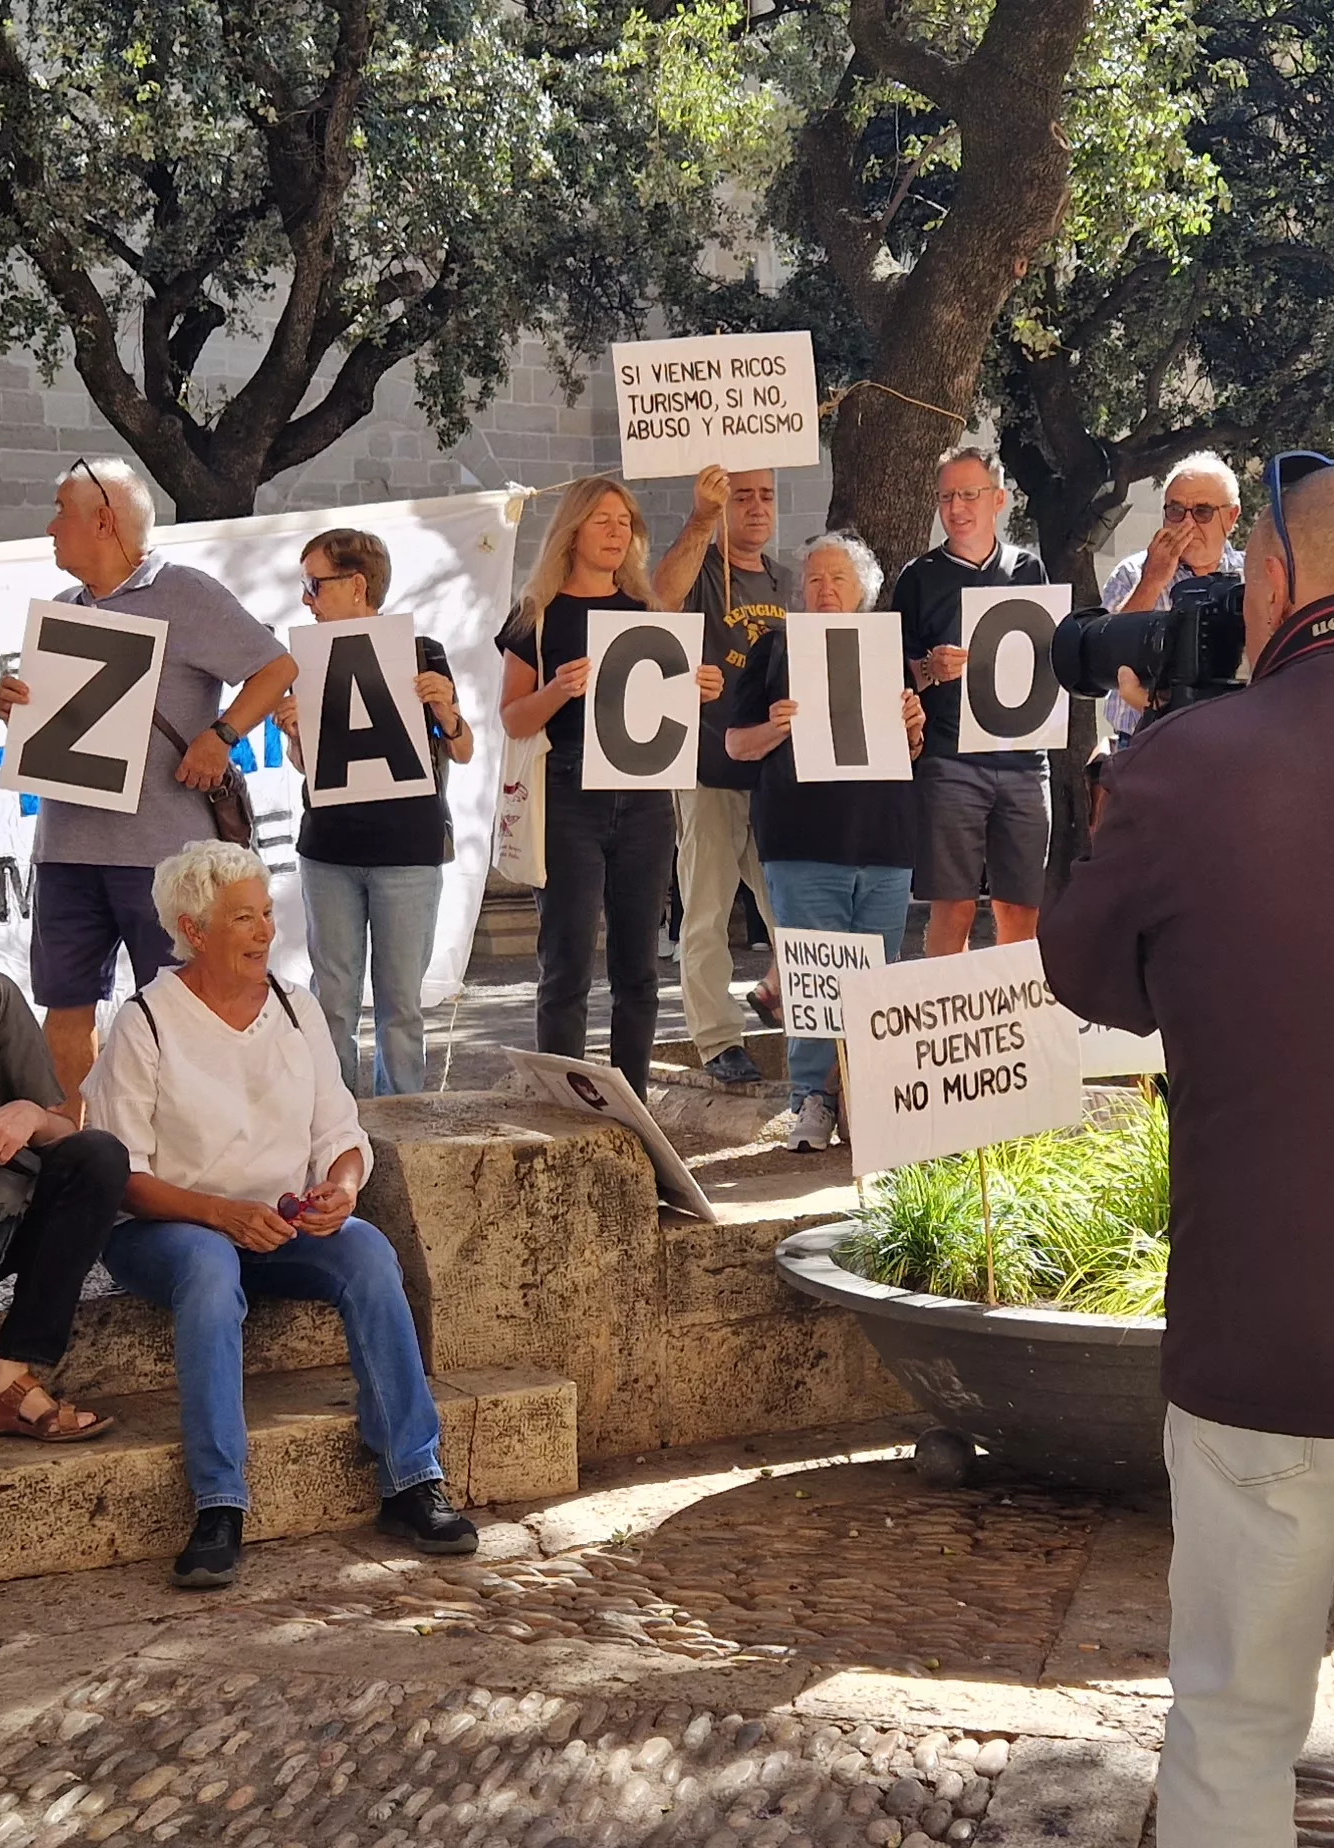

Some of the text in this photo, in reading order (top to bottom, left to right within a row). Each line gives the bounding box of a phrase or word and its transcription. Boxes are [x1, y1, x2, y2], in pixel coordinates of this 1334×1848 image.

[621, 356, 787, 386] SI VIENEN RICOS
[628, 385, 787, 415] TURISMO, SI NO,
[627, 412, 803, 441] ABUSO Y RACISMO
[723, 604, 787, 628] REFUGIAD
[967, 598, 1063, 739] O
[17, 616, 157, 794] Z
[313, 633, 428, 791] A
[594, 625, 690, 777] C
[785, 940, 870, 970] NINGUNA
[788, 971, 842, 1001] PERS
[792, 1004, 817, 1031] ES
[870, 979, 1057, 1041] CONSTRUYAMOS
[916, 1021, 1026, 1070] PUENTES
[894, 1062, 1028, 1114] NO MUROS
